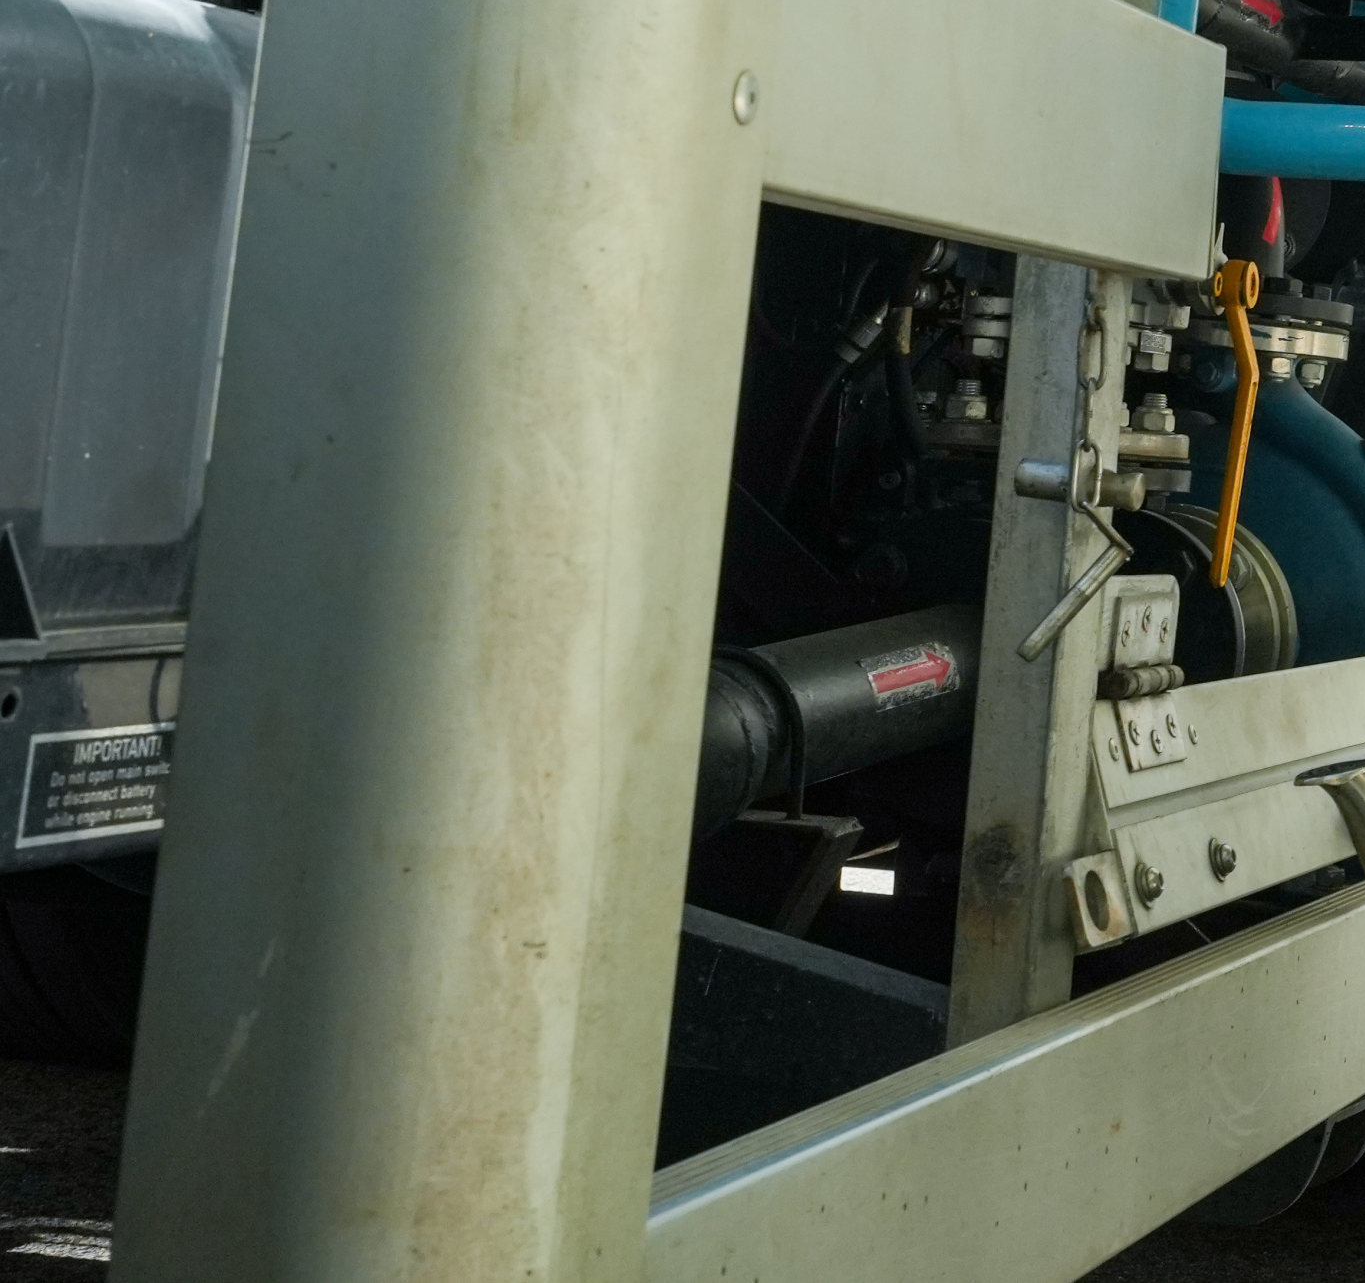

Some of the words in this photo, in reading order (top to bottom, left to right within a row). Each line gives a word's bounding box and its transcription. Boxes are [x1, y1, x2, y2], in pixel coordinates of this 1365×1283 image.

[73, 736, 162, 765] IMPORTANT!
[62, 786, 119, 806] disconnect
[120, 784, 156, 800] battery
